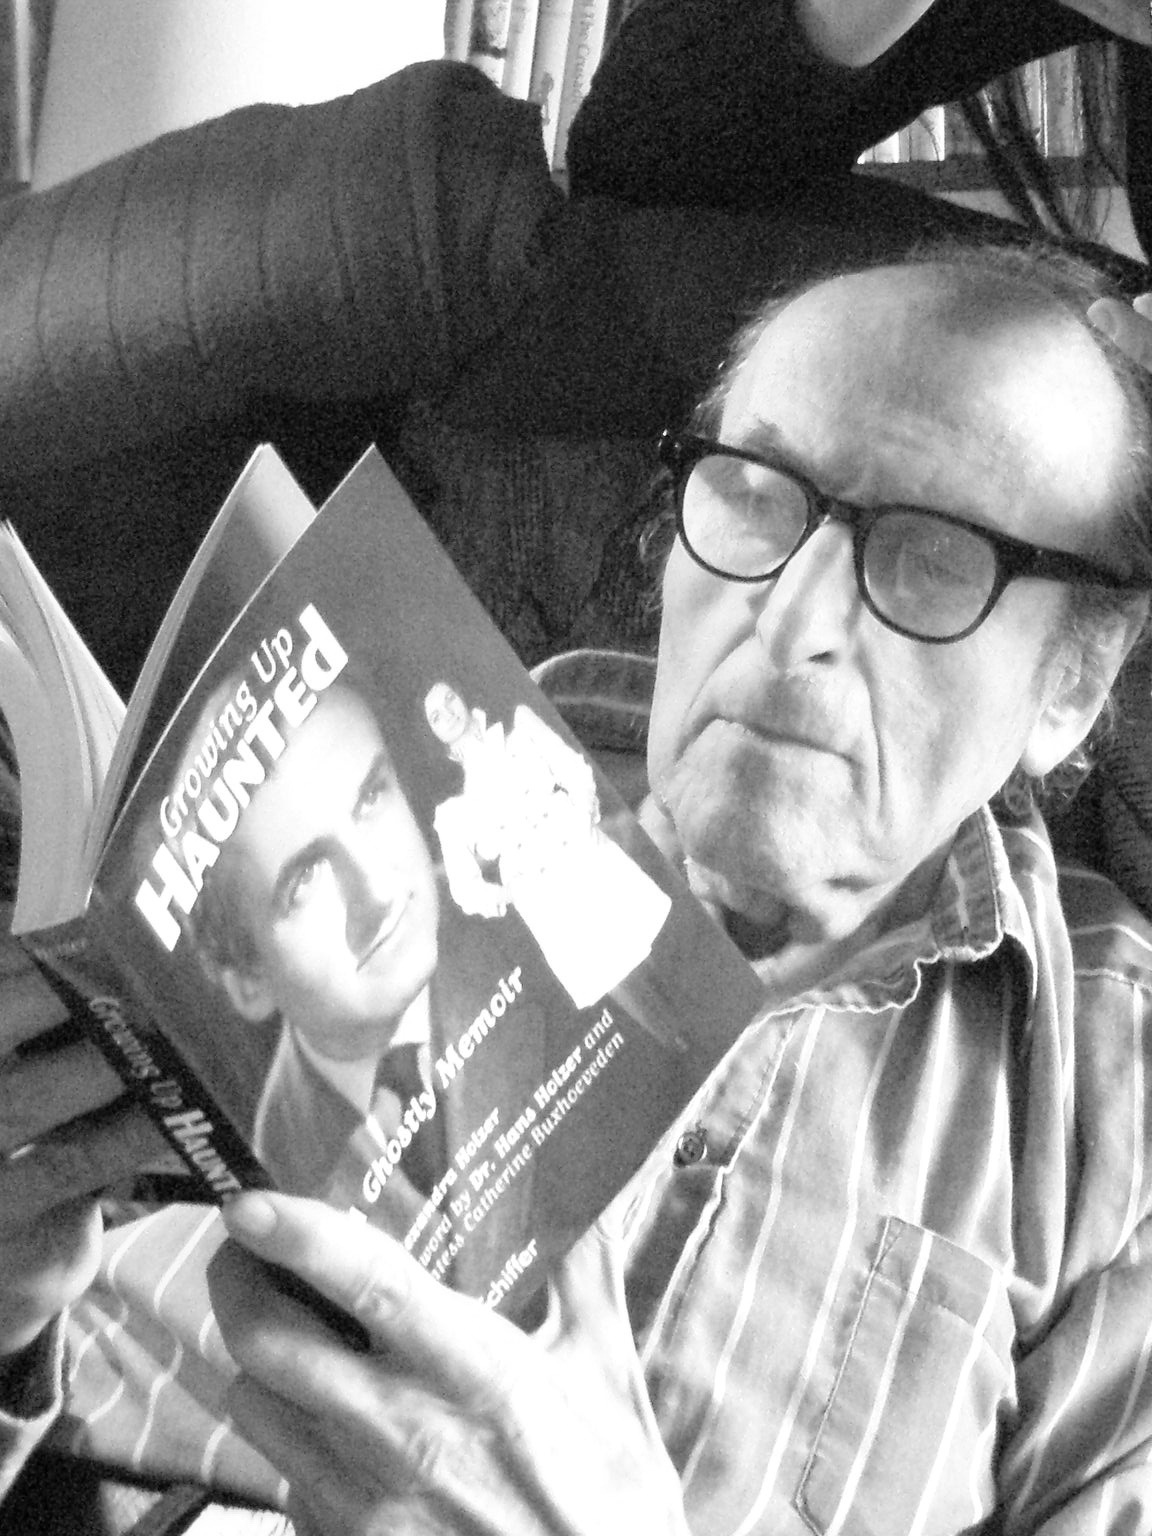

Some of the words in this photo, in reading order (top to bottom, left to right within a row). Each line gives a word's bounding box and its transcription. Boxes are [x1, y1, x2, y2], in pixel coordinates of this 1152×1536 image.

[159, 680, 258, 839] Growing
[250, 627, 294, 684] Up
[151, 1080, 182, 1108] Up
[162, 1110, 243, 1195] HAUNT
[362, 1089, 437, 1204] Ghostly
[435, 965, 524, 1089] Memoir
[419, 1216, 453, 1268] word
[449, 1190, 473, 1218] by
[468, 1160, 498, 1197] Dr.
[494, 1106, 538, 1160] Hans
[533, 1045, 583, 1111] Holzer
[583, 1008, 615, 1050] and
[462, 1147, 534, 1234] Catherine
[530, 1030, 625, 1149] Buxhoeveden
[404, 1167, 458, 1252] exandra
[454, 1106, 501, 1170] Holzer
[482, 1239, 539, 1308] chiffer
